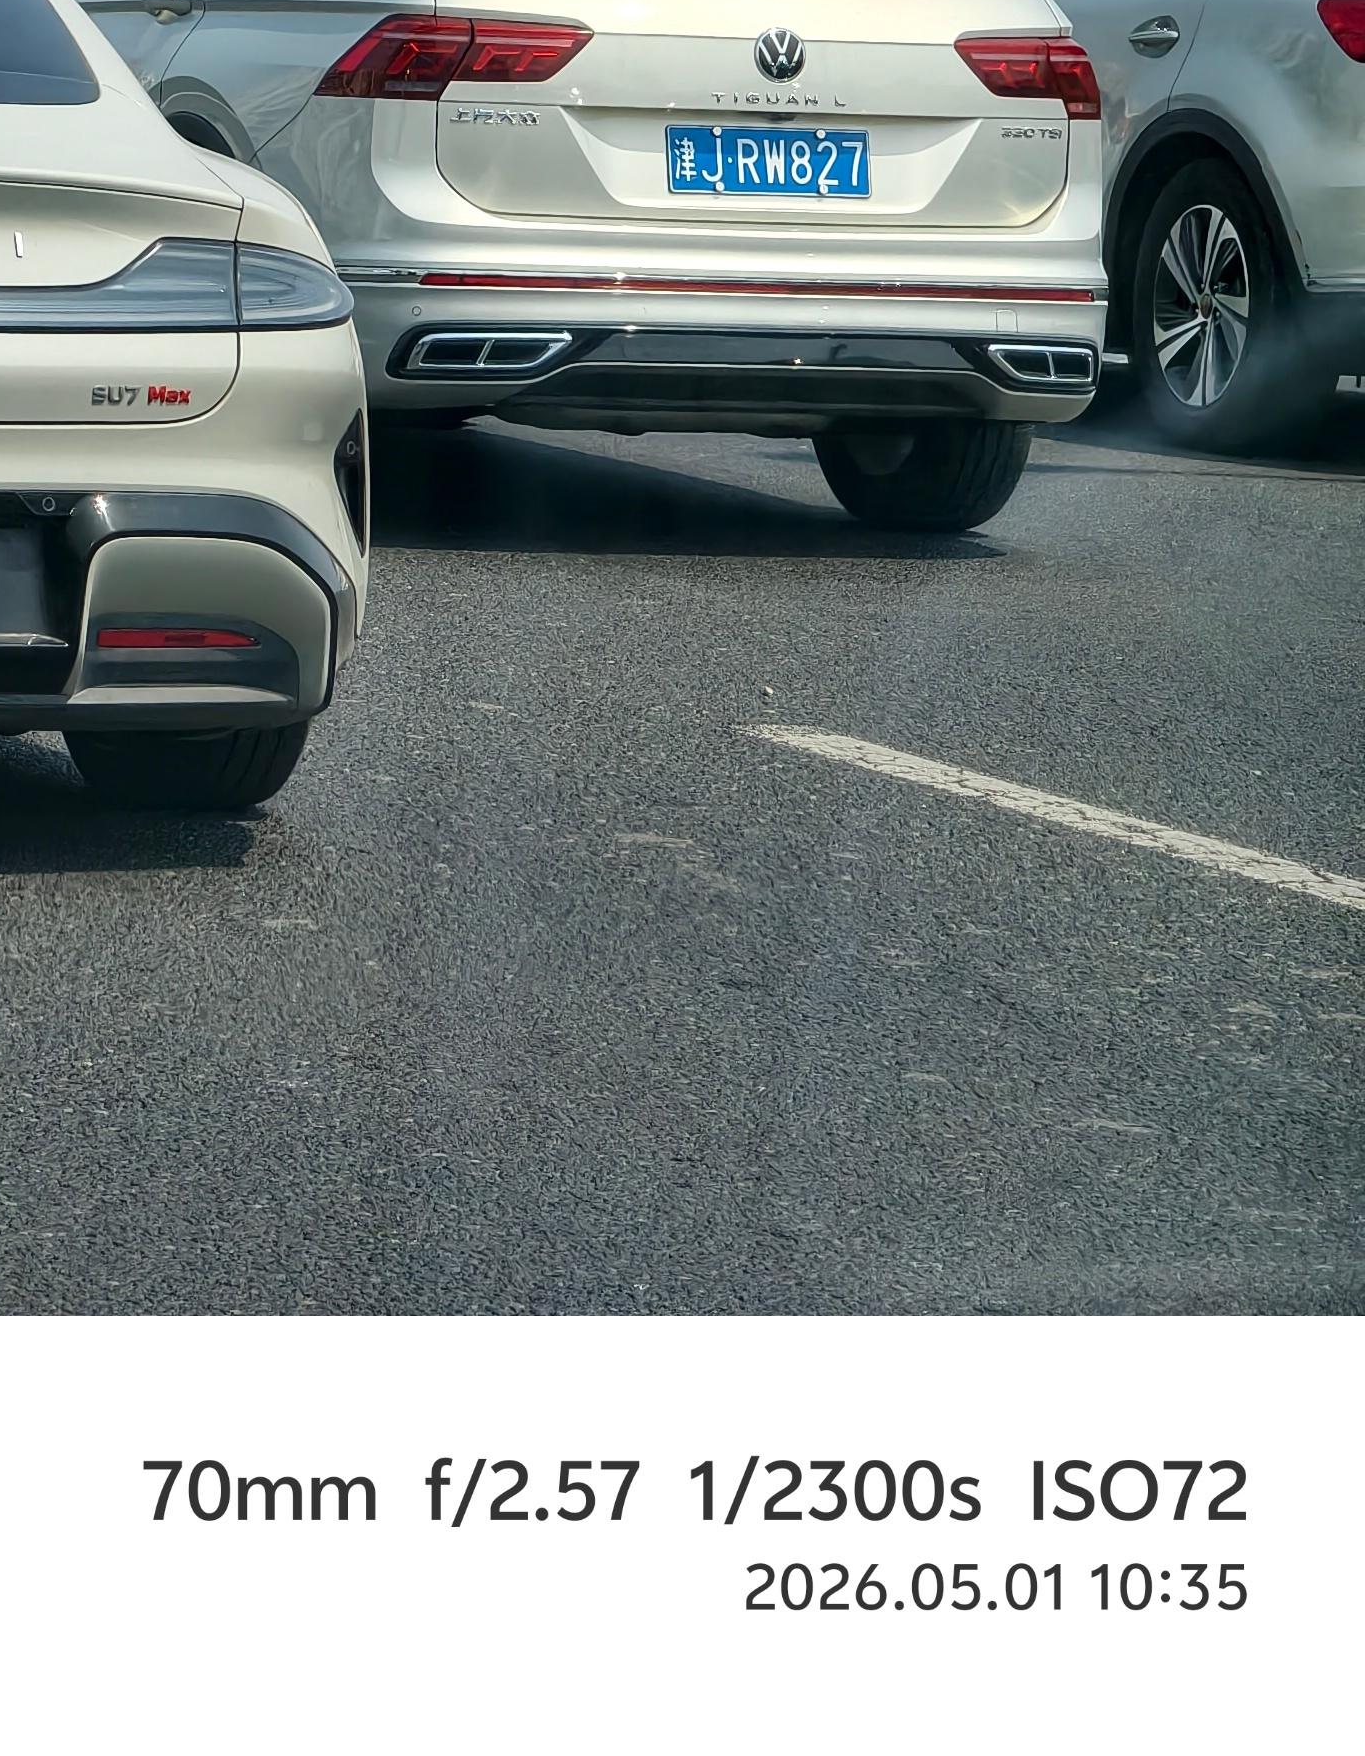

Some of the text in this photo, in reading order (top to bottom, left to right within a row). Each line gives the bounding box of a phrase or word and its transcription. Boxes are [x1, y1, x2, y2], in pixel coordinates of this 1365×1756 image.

[712, 91, 819, 106] TIGUAN
[91, 385, 191, 406] SU7 Max
